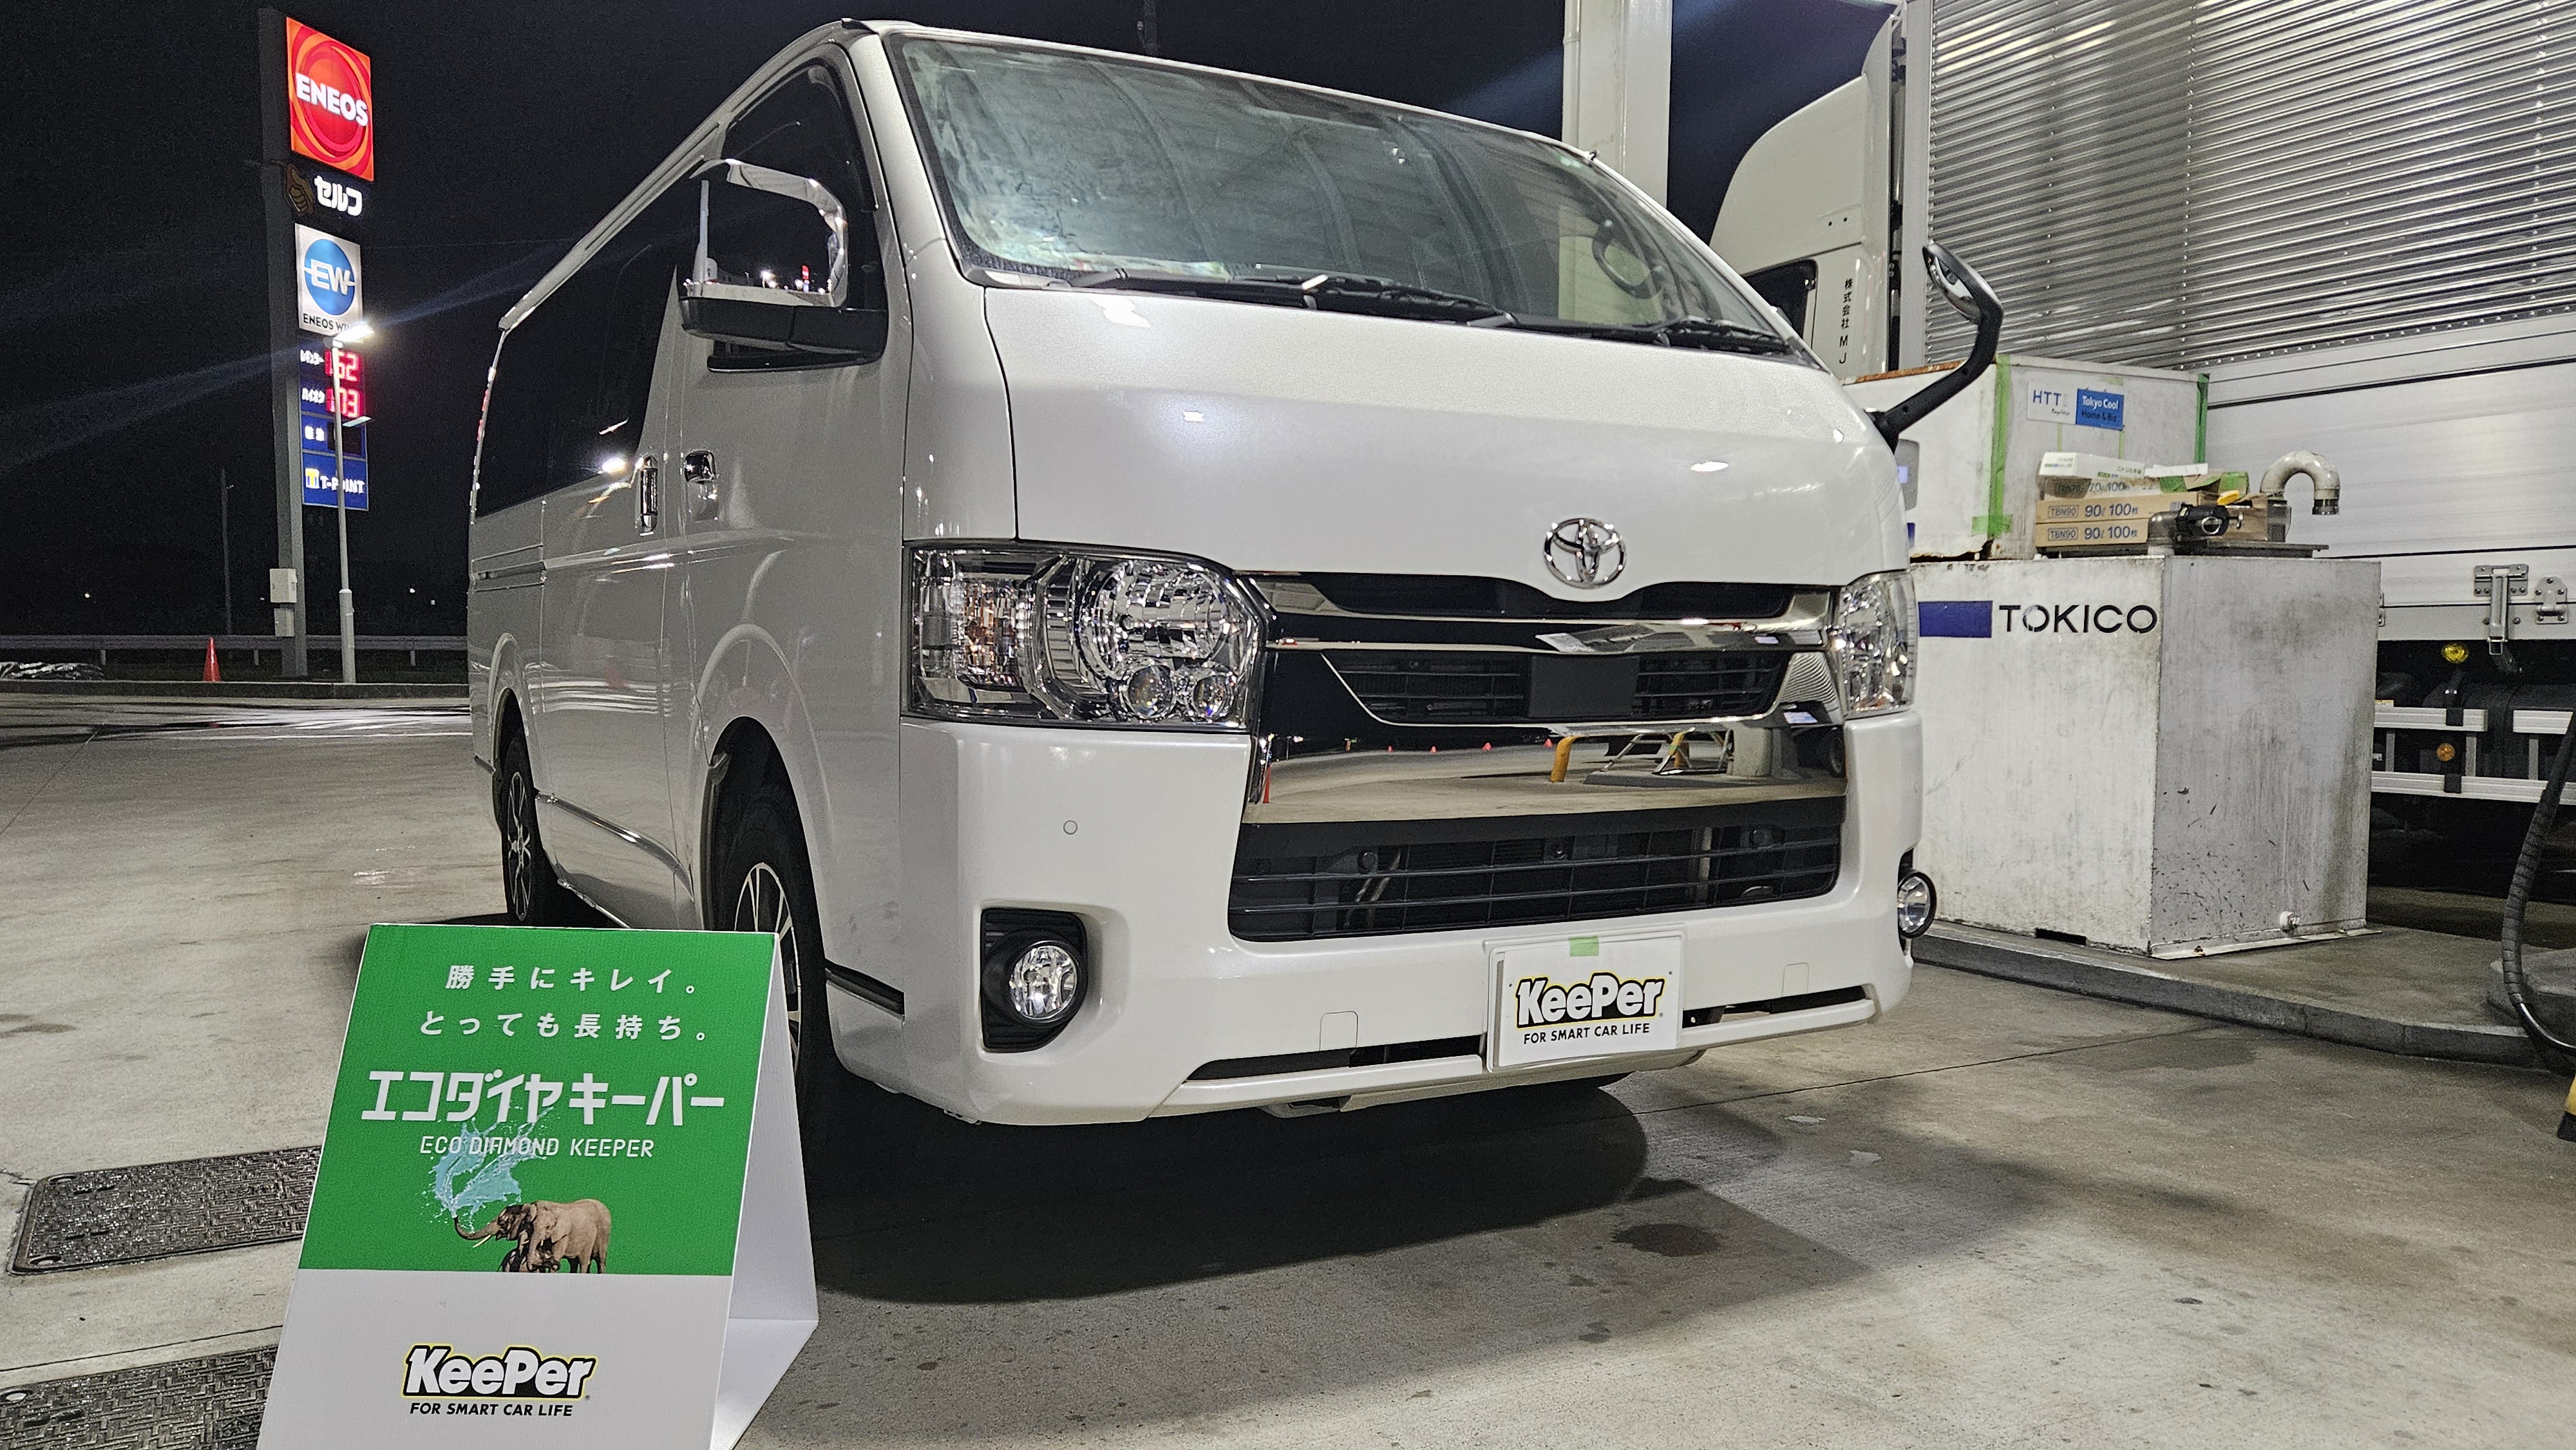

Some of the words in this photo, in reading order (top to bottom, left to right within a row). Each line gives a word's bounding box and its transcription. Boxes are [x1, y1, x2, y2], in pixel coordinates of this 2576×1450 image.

[296, 72, 368, 127] ENEOS
[314, 174, 362, 216] セルフ
[303, 313, 334, 330] ENEOS
[2032, 389, 2062, 406] HTT
[2081, 395, 2103, 410] Tokyo
[2103, 399, 2119, 410] Cool
[2081, 409, 2101, 420] Home
[2107, 412, 2117, 422] Biz
[1999, 604, 2157, 634] TOKICO
[446, 965, 695, 995] 勝手にキレイ。
[1515, 972, 1665, 1029] KeePer
[420, 1011, 706, 1042] とっても長持ち。
[1523, 1032, 1546, 1045] FOR
[1551, 1027, 1590, 1042] SMART
[1594, 1025, 1618, 1037] CAR
[1622, 1022, 1650, 1035] LIFE
[361, 1068, 725, 1126] エコダイヤキーパー
[420, 1135, 462, 1155] ECO
[468, 1136, 559, 1156] DIAMOND
[569, 1138, 654, 1158] KEEPER
[402, 1344, 596, 1399] KeePer
[410, 1402, 441, 1415] FOR
[446, 1403, 498, 1416] SMART
[503, 1404, 533, 1417] CAR
[538, 1404, 573, 1417] LIFE
